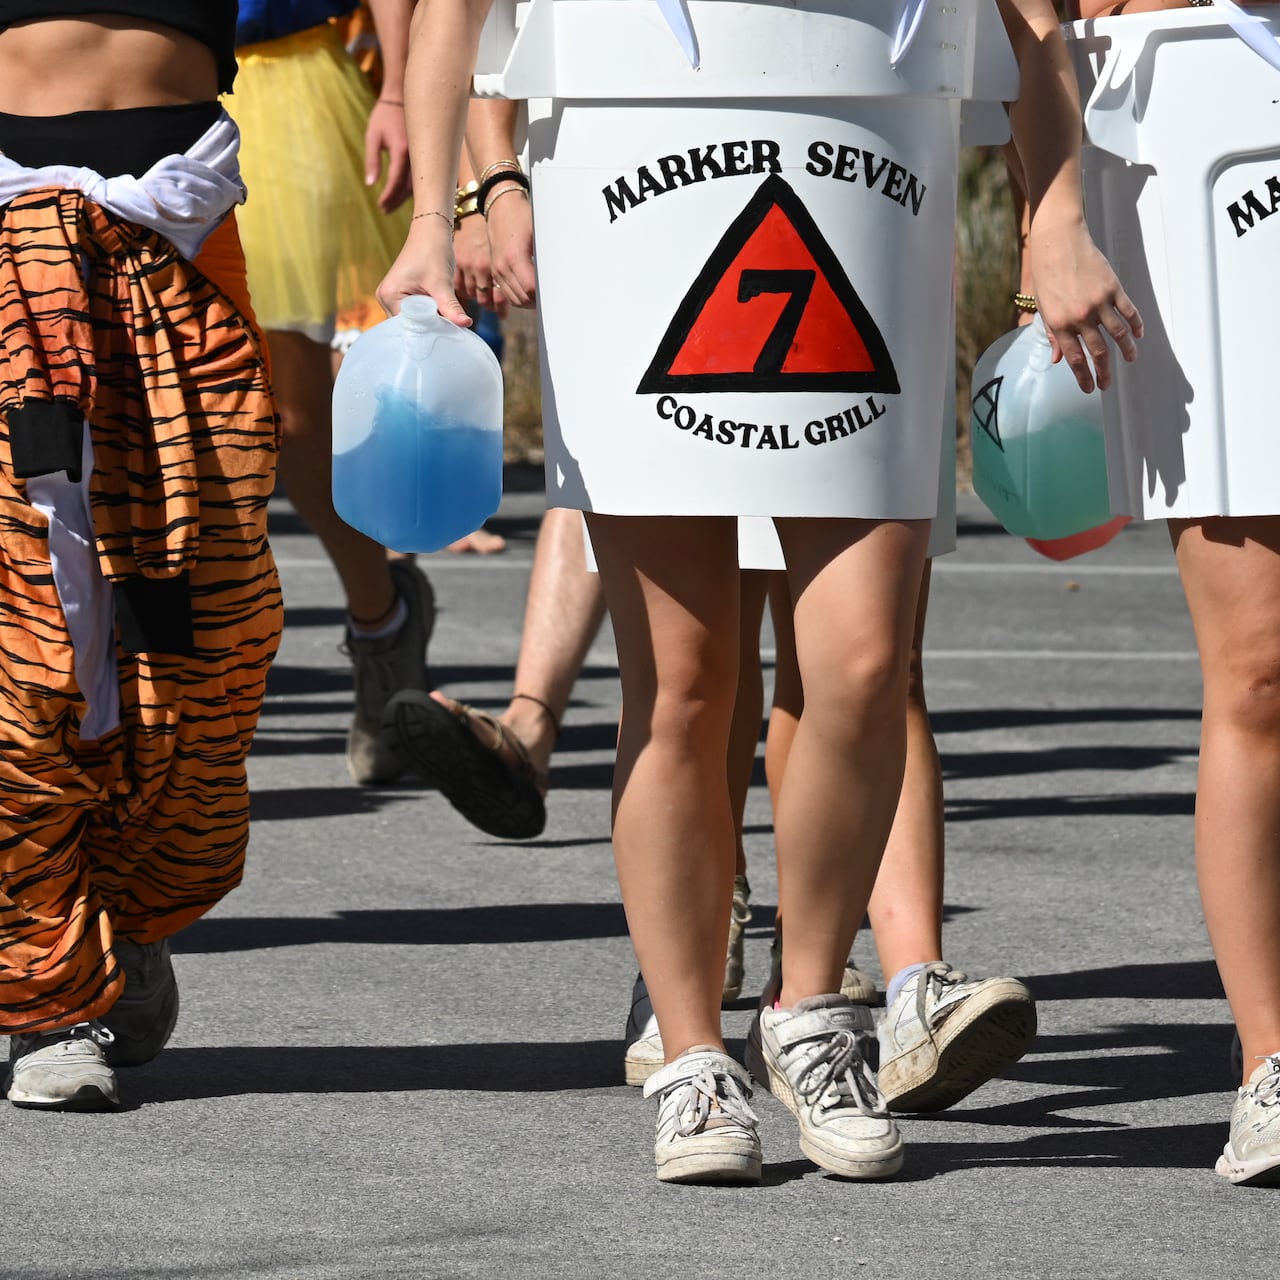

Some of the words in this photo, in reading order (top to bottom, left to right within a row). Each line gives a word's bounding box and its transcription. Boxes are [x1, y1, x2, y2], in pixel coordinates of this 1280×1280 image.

[601, 140, 783, 224] MARKER
[805, 141, 927, 216] SEVEN
[737, 269, 816, 375] 7
[656, 395, 800, 450] COASTAL
[804, 395, 887, 446] GRILL
